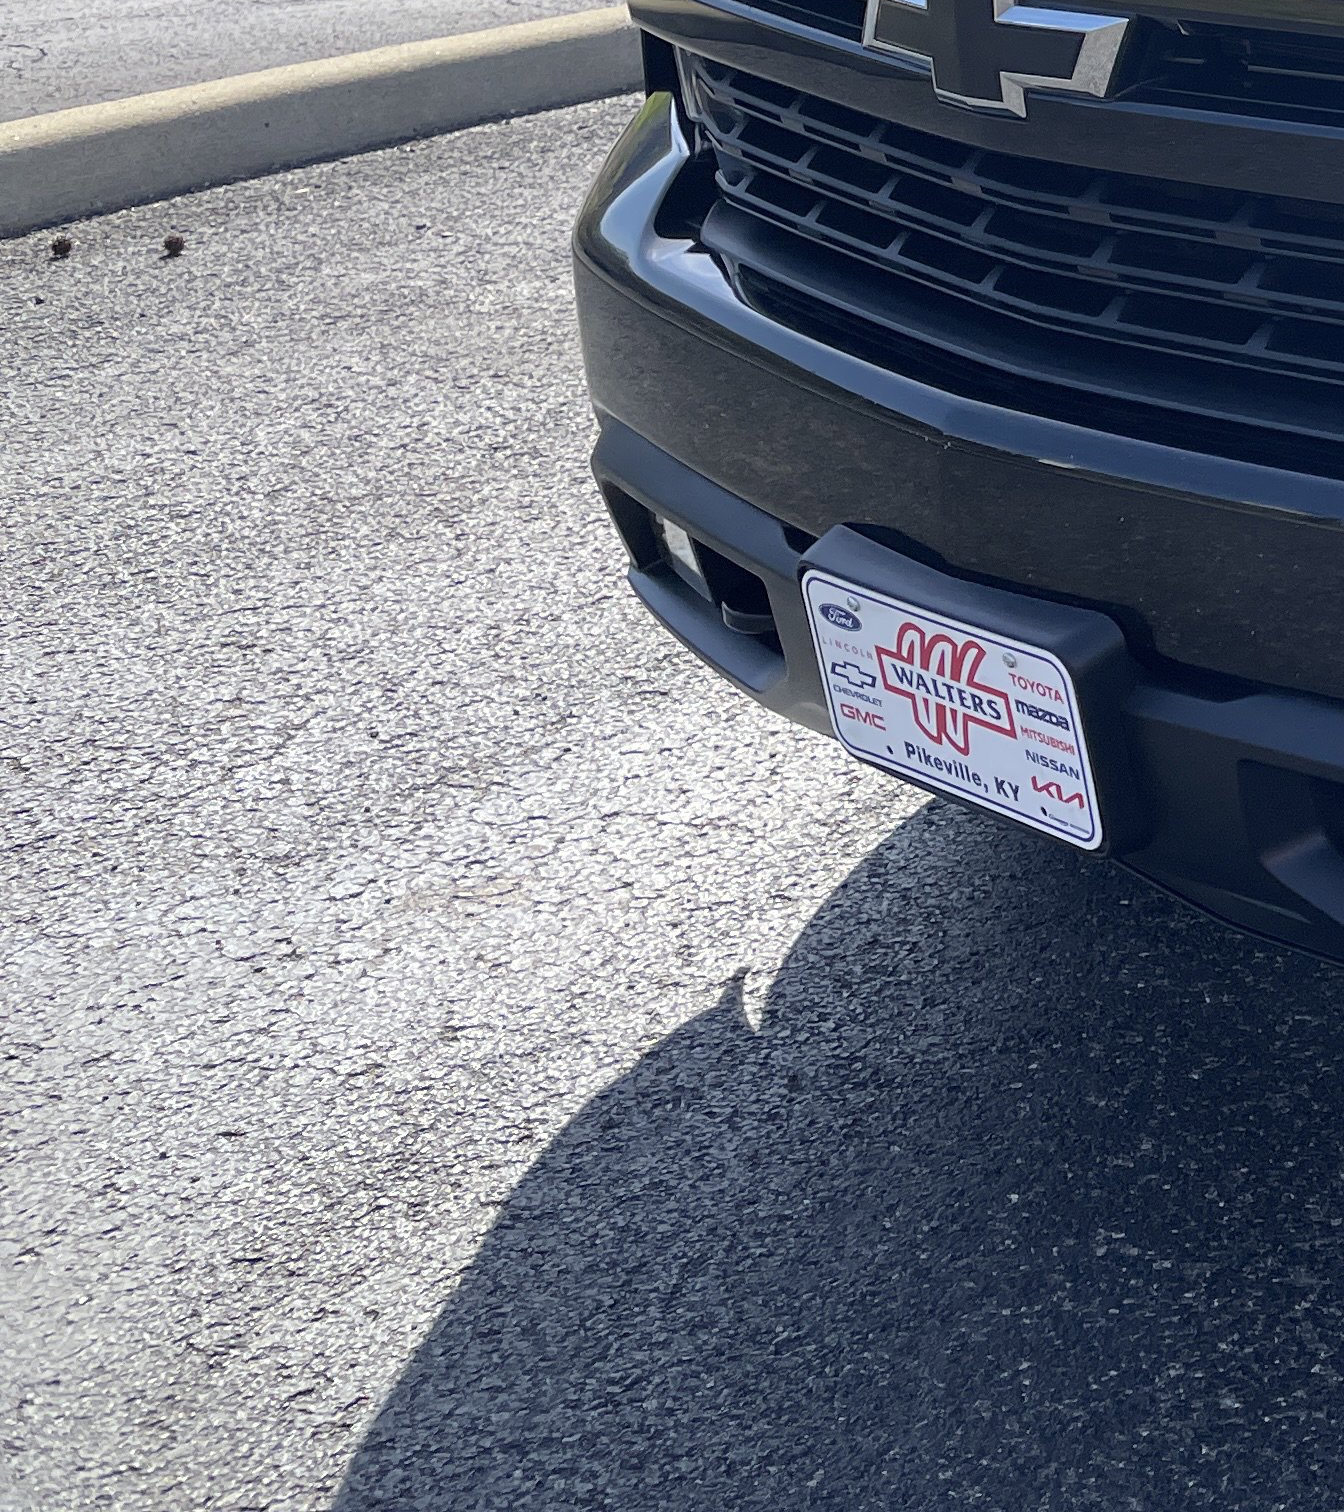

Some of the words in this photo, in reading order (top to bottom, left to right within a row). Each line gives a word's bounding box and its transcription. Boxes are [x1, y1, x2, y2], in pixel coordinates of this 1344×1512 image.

[827, 607, 854, 628] Ford
[822, 637, 874, 660] LINCOLN
[832, 684, 883, 707] CHEVROLET
[891, 663, 1002, 720] WALTERS
[1008, 672, 1064, 704] TOYOTA
[840, 703, 887, 731] GMC
[1020, 725, 1076, 756] MITSUBISHI
[903, 741, 989, 793] Pikeville,
[994, 776, 1020, 802] KY
[1025, 749, 1081, 780] NISSAN
